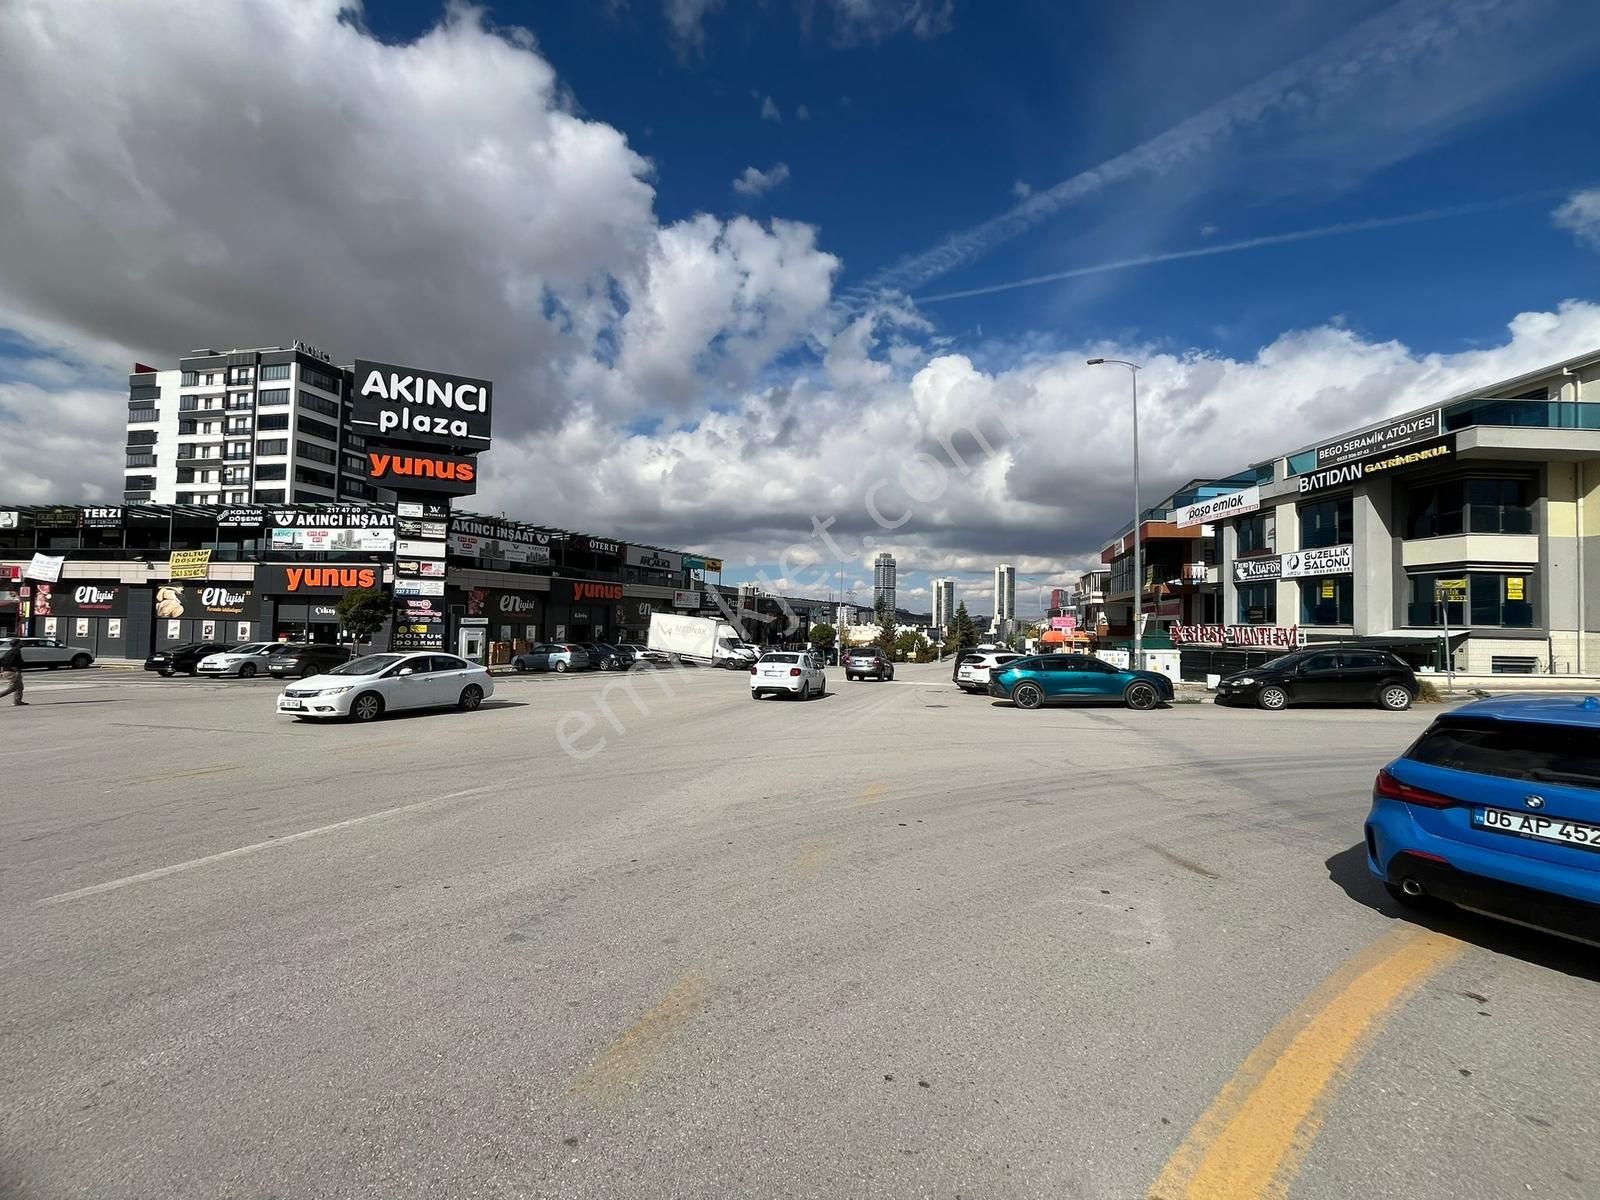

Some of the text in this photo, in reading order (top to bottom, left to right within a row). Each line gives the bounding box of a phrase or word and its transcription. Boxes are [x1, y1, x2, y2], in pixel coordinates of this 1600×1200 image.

[360, 369, 487, 413] AKINCI
[379, 407, 468, 438] plaza
[1319, 445, 1342, 459] BEGO
[1343, 431, 1384, 452] SERAMİK
[1386, 414, 1435, 440] ATÖLYESİ
[369, 453, 474, 481] yunus
[1300, 445, 1450, 492] BATIDAN GAYRİMENKUL
[1212, 495, 1244, 512] emlak
[296, 514, 342, 526] AKINCI
[452, 520, 493, 536] AKINCI
[1304, 557, 1350, 570] SALONU
[286, 568, 375, 591] yunus
[574, 582, 624, 600] yunus
[1486, 810, 1512, 828] 06
[1518, 816, 1551, 834] AP
[1558, 822, 1600, 845] 452
